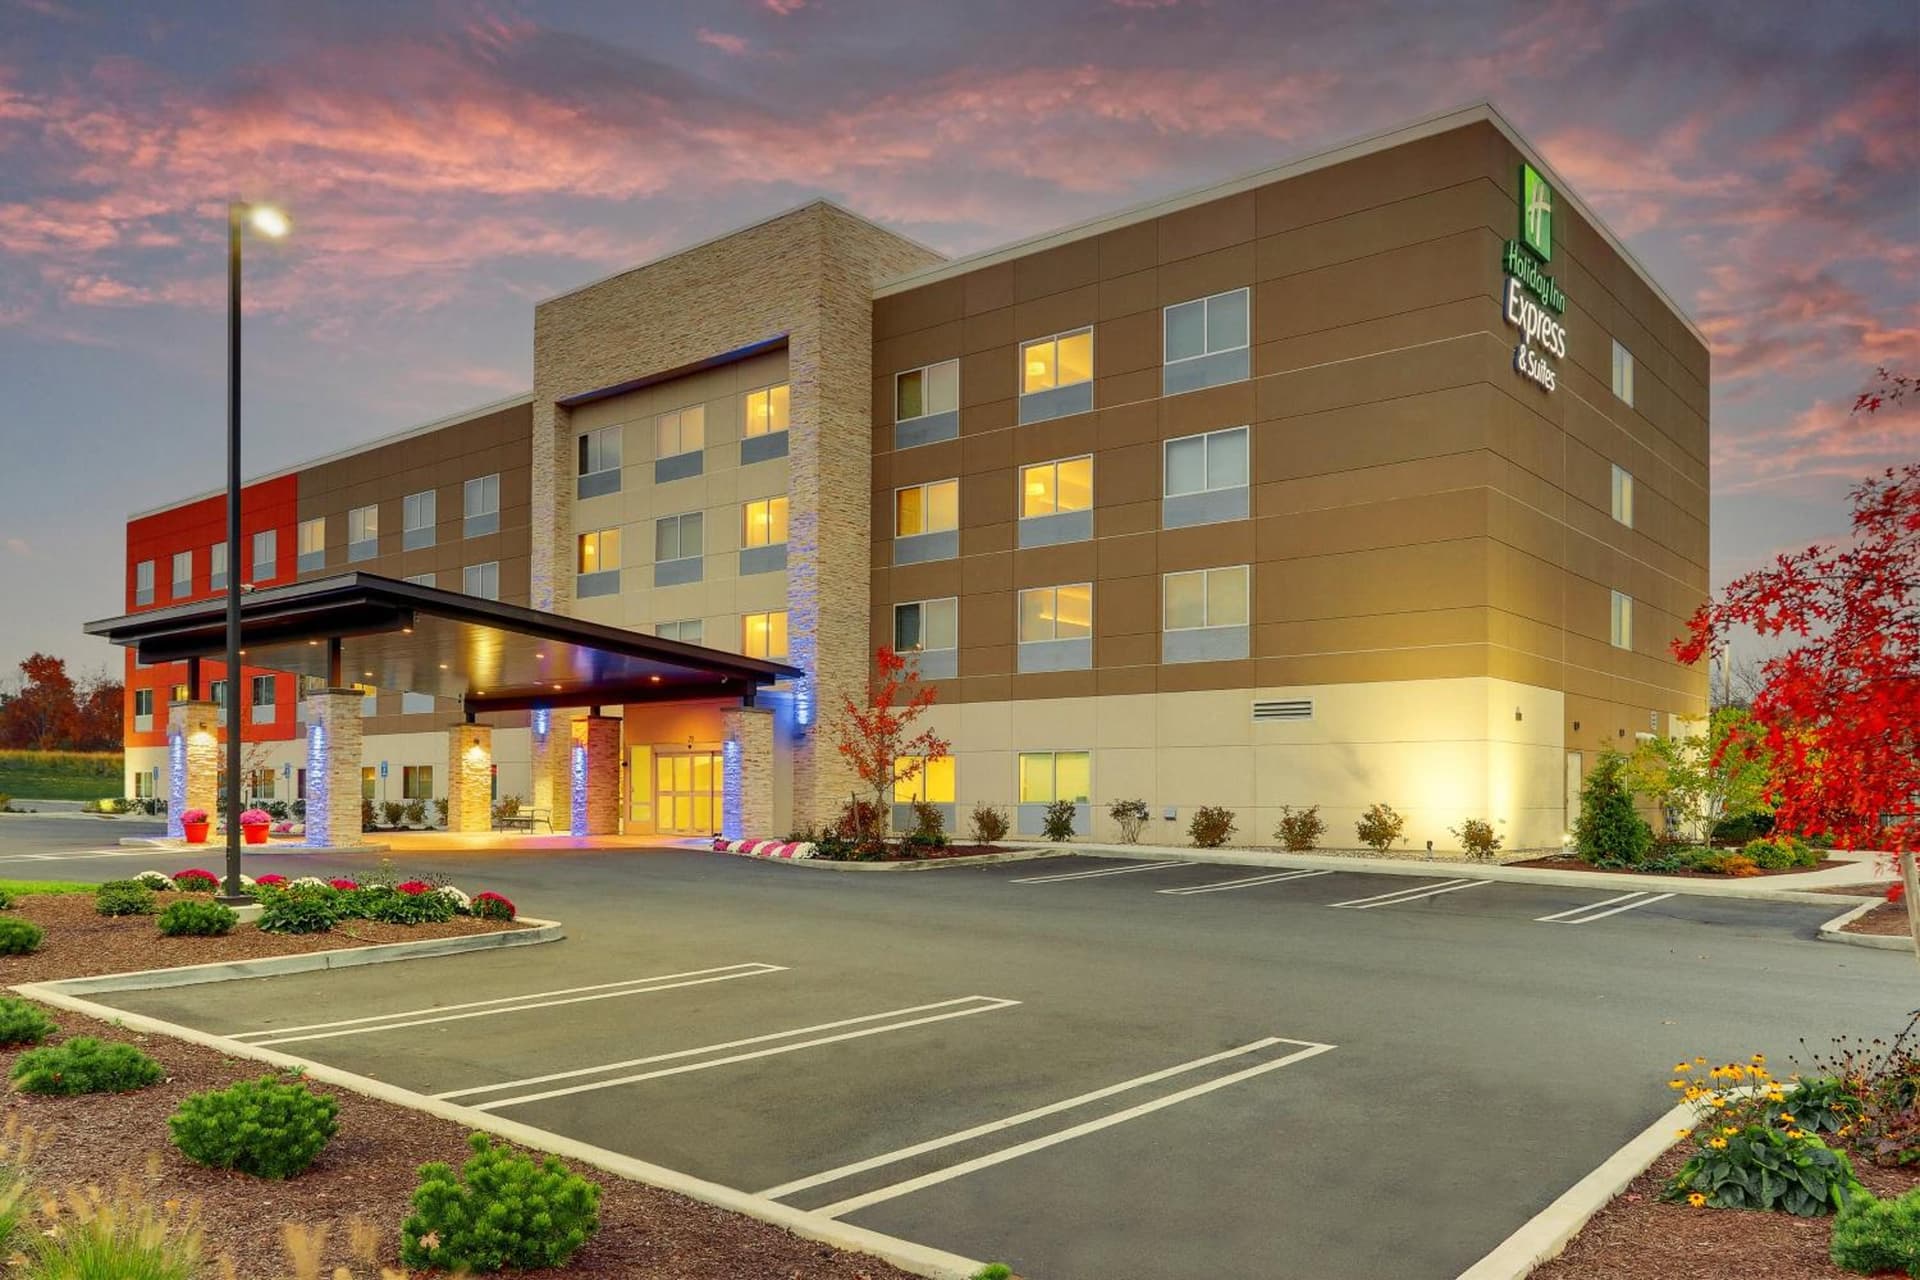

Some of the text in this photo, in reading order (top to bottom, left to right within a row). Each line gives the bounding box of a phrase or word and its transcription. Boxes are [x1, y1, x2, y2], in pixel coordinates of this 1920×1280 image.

[1509, 240, 1565, 312] Holiday Inn
[1508, 278, 1566, 358] Express
[1518, 344, 1556, 391] & Suites
